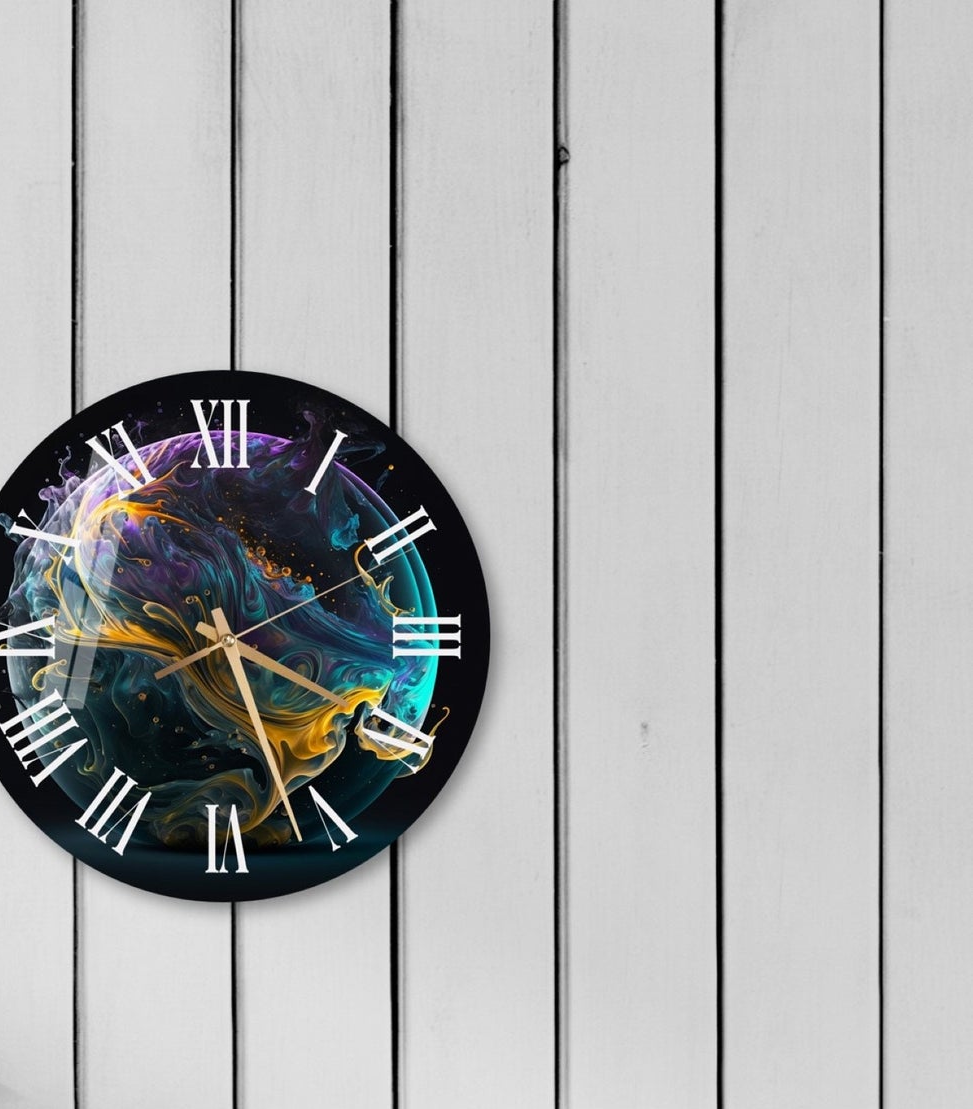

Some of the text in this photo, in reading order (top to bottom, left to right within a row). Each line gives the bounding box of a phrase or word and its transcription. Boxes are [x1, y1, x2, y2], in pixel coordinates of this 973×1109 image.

[85, 421, 157, 500] XI
[190, 399, 250, 468] XII
[304, 429, 348, 496] I
[9, 508, 81, 565] X
[364, 505, 437, 565] II
[392, 613, 461, 659] III
[362, 706, 436, 774] IV
[74, 766, 153, 856] VII
[205, 804, 249, 873] VI
[308, 785, 358, 851] V
